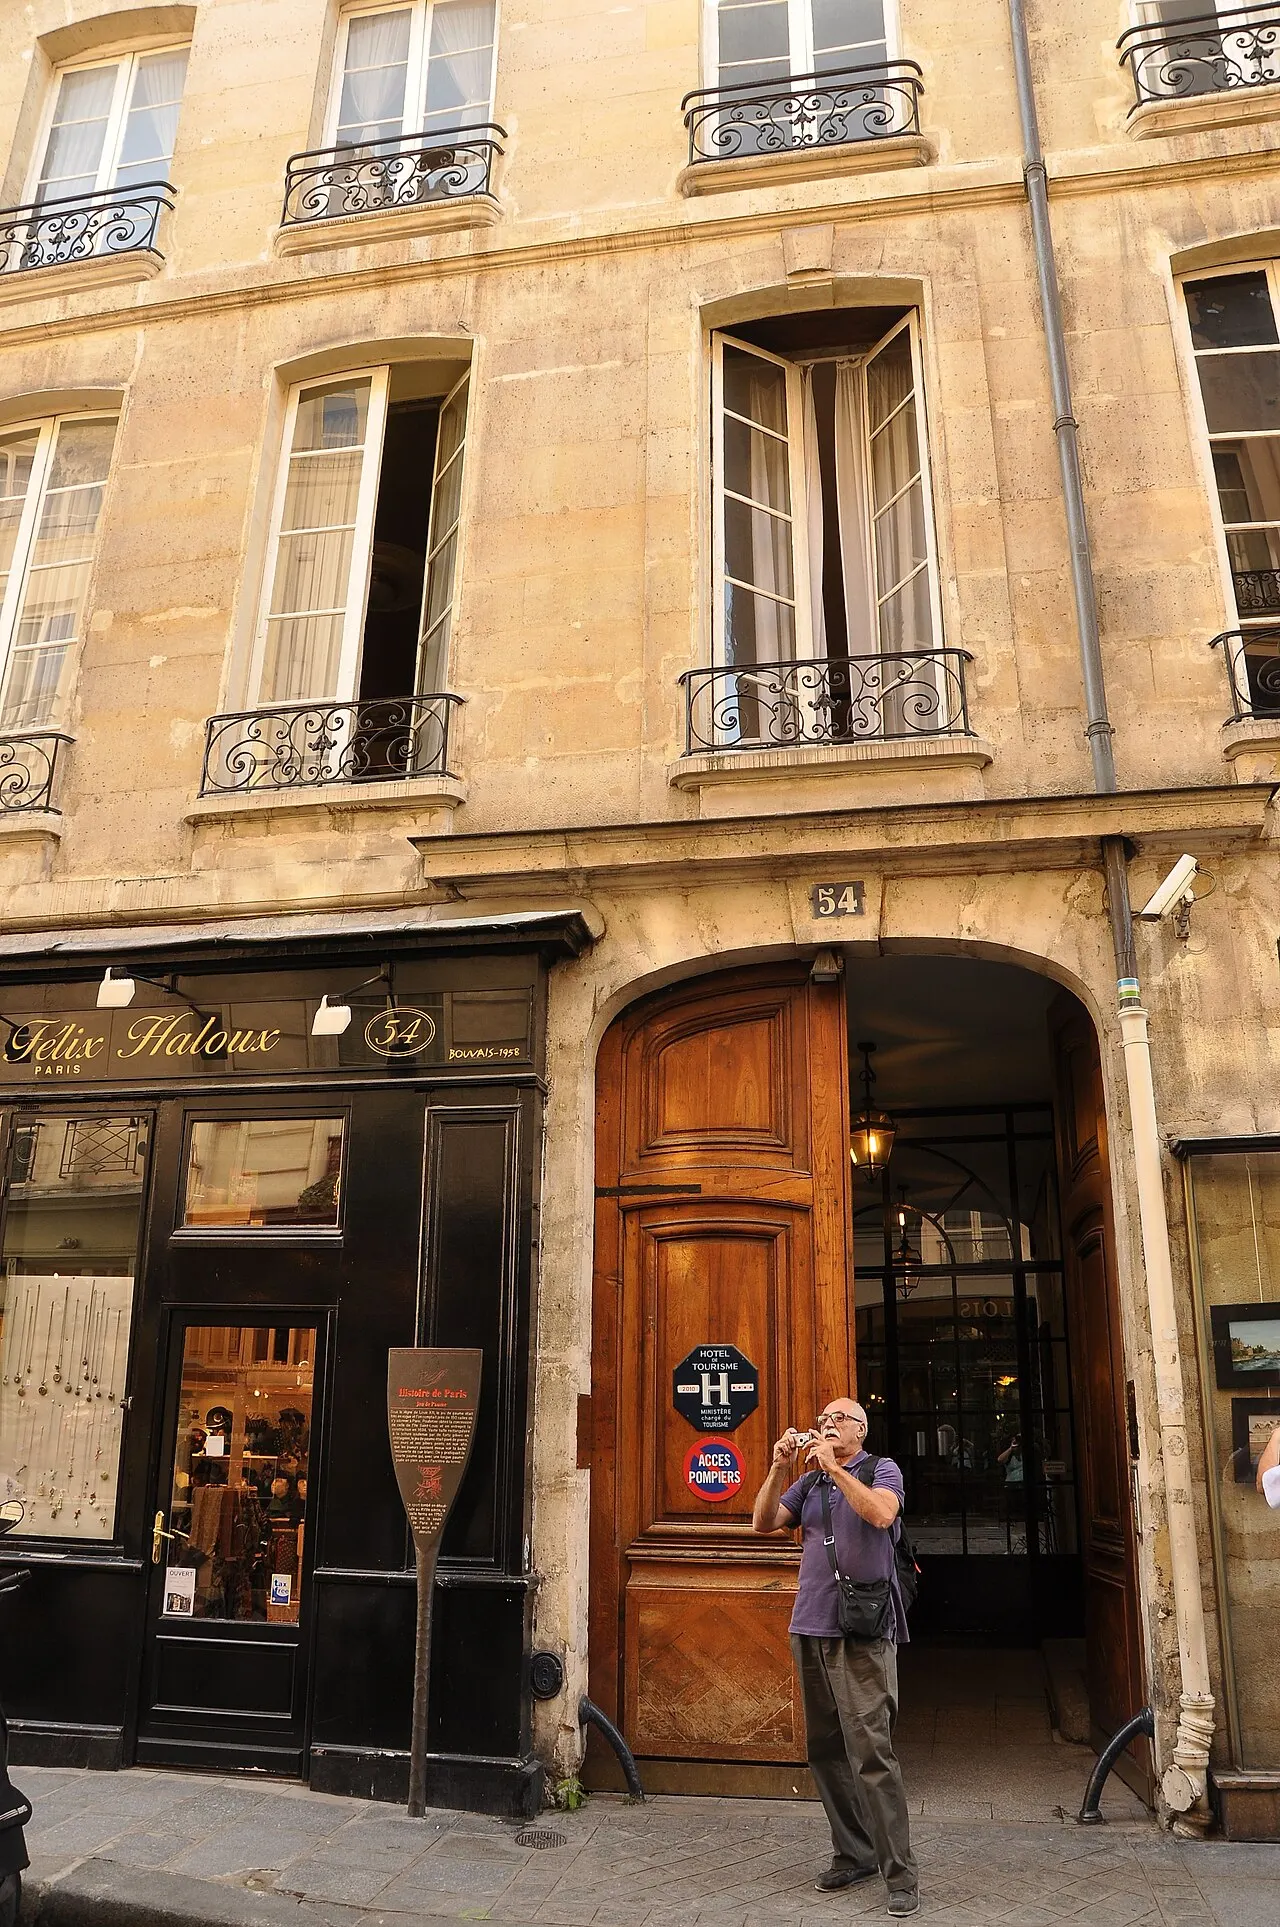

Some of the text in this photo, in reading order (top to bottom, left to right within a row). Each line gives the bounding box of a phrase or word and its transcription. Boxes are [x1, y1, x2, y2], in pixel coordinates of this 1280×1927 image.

[818, 886, 858, 915] 54
[4, 1011, 281, 1062] Félix Haloux
[375, 1018, 422, 1045] 54
[34, 1064, 82, 1075] PARIS
[700, 1350, 730, 1358] HOTEL
[692, 1363, 739, 1371] TOURISME
[399, 1388, 468, 1399] Histoire de Paris
[700, 1372, 731, 1406] H
[698, 1453, 731, 1467] ACCES
[688, 1470, 741, 1484] POMPIERS
[274, 1579, 287, 1588] tax
